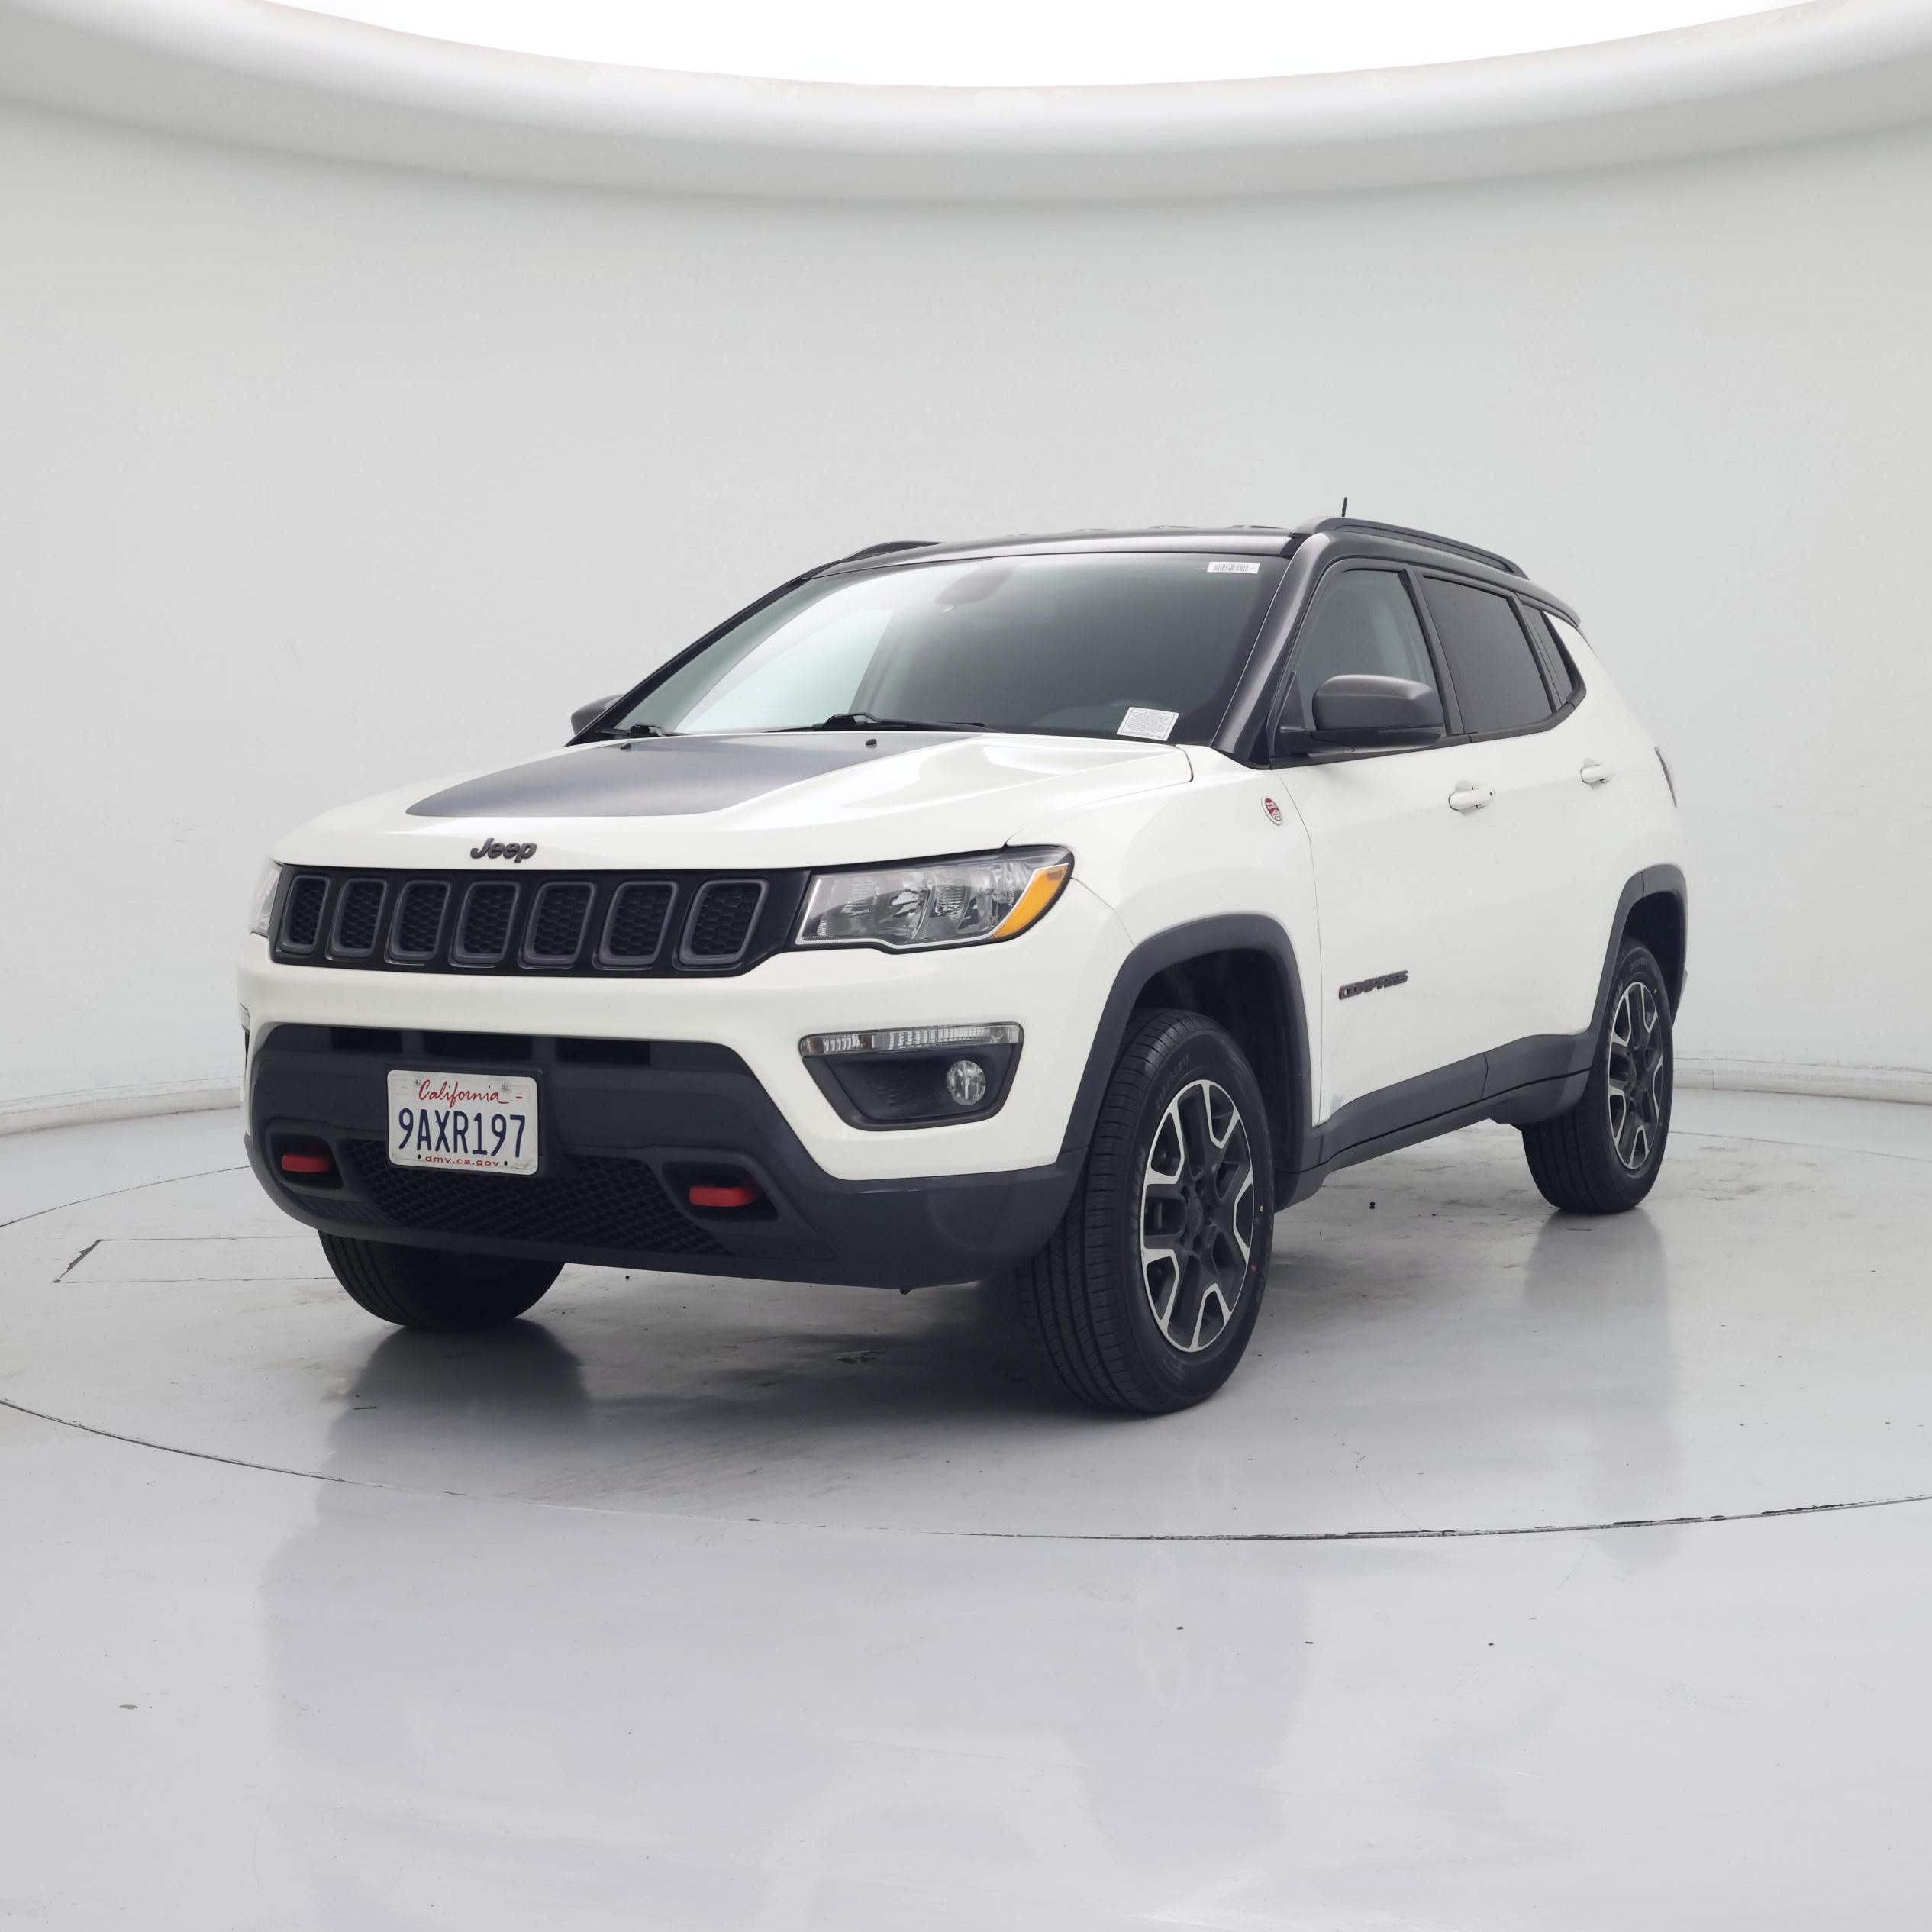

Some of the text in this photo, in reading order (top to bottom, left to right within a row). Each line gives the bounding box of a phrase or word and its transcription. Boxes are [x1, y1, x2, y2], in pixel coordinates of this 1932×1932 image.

[470, 838, 537, 863] Jeep
[418, 1079, 509, 1108] California
[398, 1108, 525, 1158] 9AXR197
[425, 1155, 500, 1167] dmv.ca.gov
